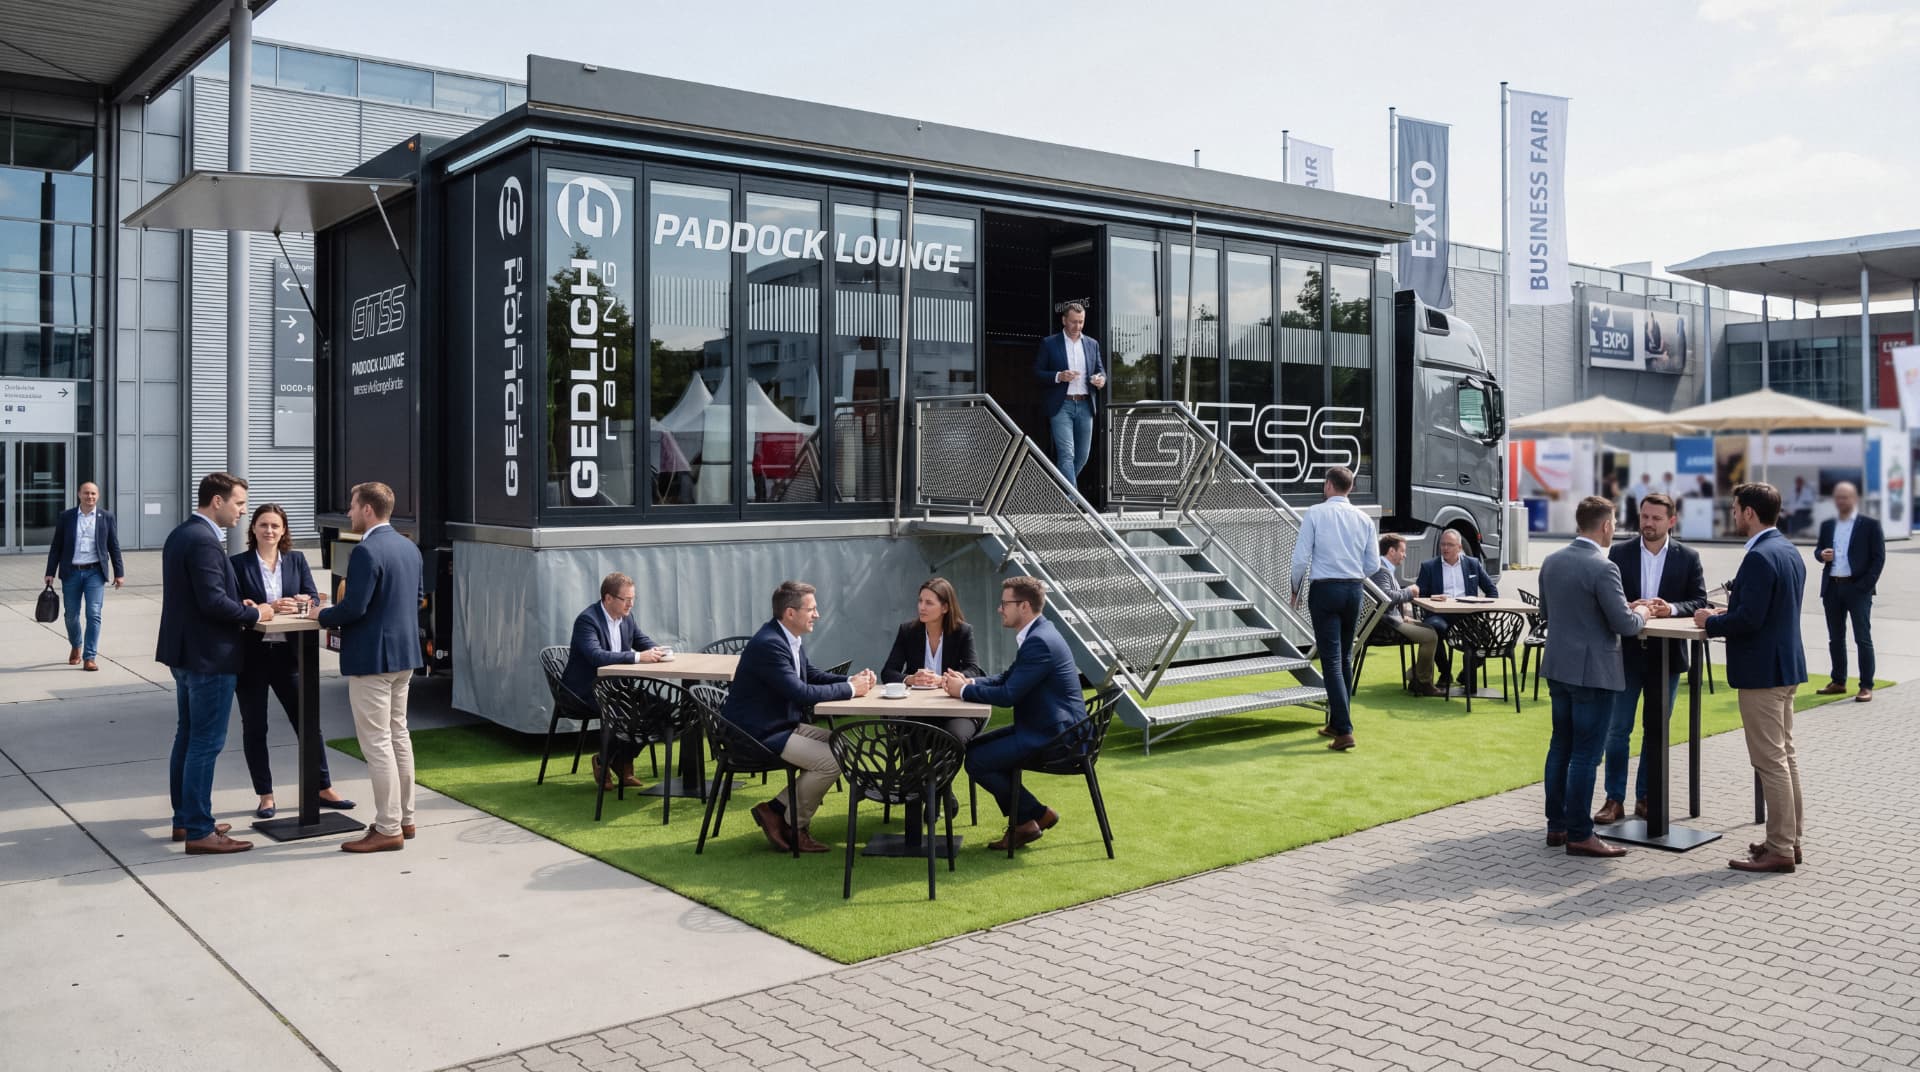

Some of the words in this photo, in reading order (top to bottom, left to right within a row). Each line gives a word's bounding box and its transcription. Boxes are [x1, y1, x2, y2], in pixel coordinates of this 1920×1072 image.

[1530, 109, 1548, 163] FAIR
[1411, 160, 1437, 258] EXPO
[1530, 170, 1548, 290] BUSINESS
[654, 213, 828, 261] PADDOCK
[835, 232, 962, 274] LOUNGE
[351, 284, 406, 341] GTSS
[1602, 331, 1629, 350] EXPO
[352, 358, 378, 376] PADDOCK
[379, 352, 404, 371] LOUNGE
[504, 257, 518, 497] GEDLICH
[570, 257, 598, 498] GEDLICH
